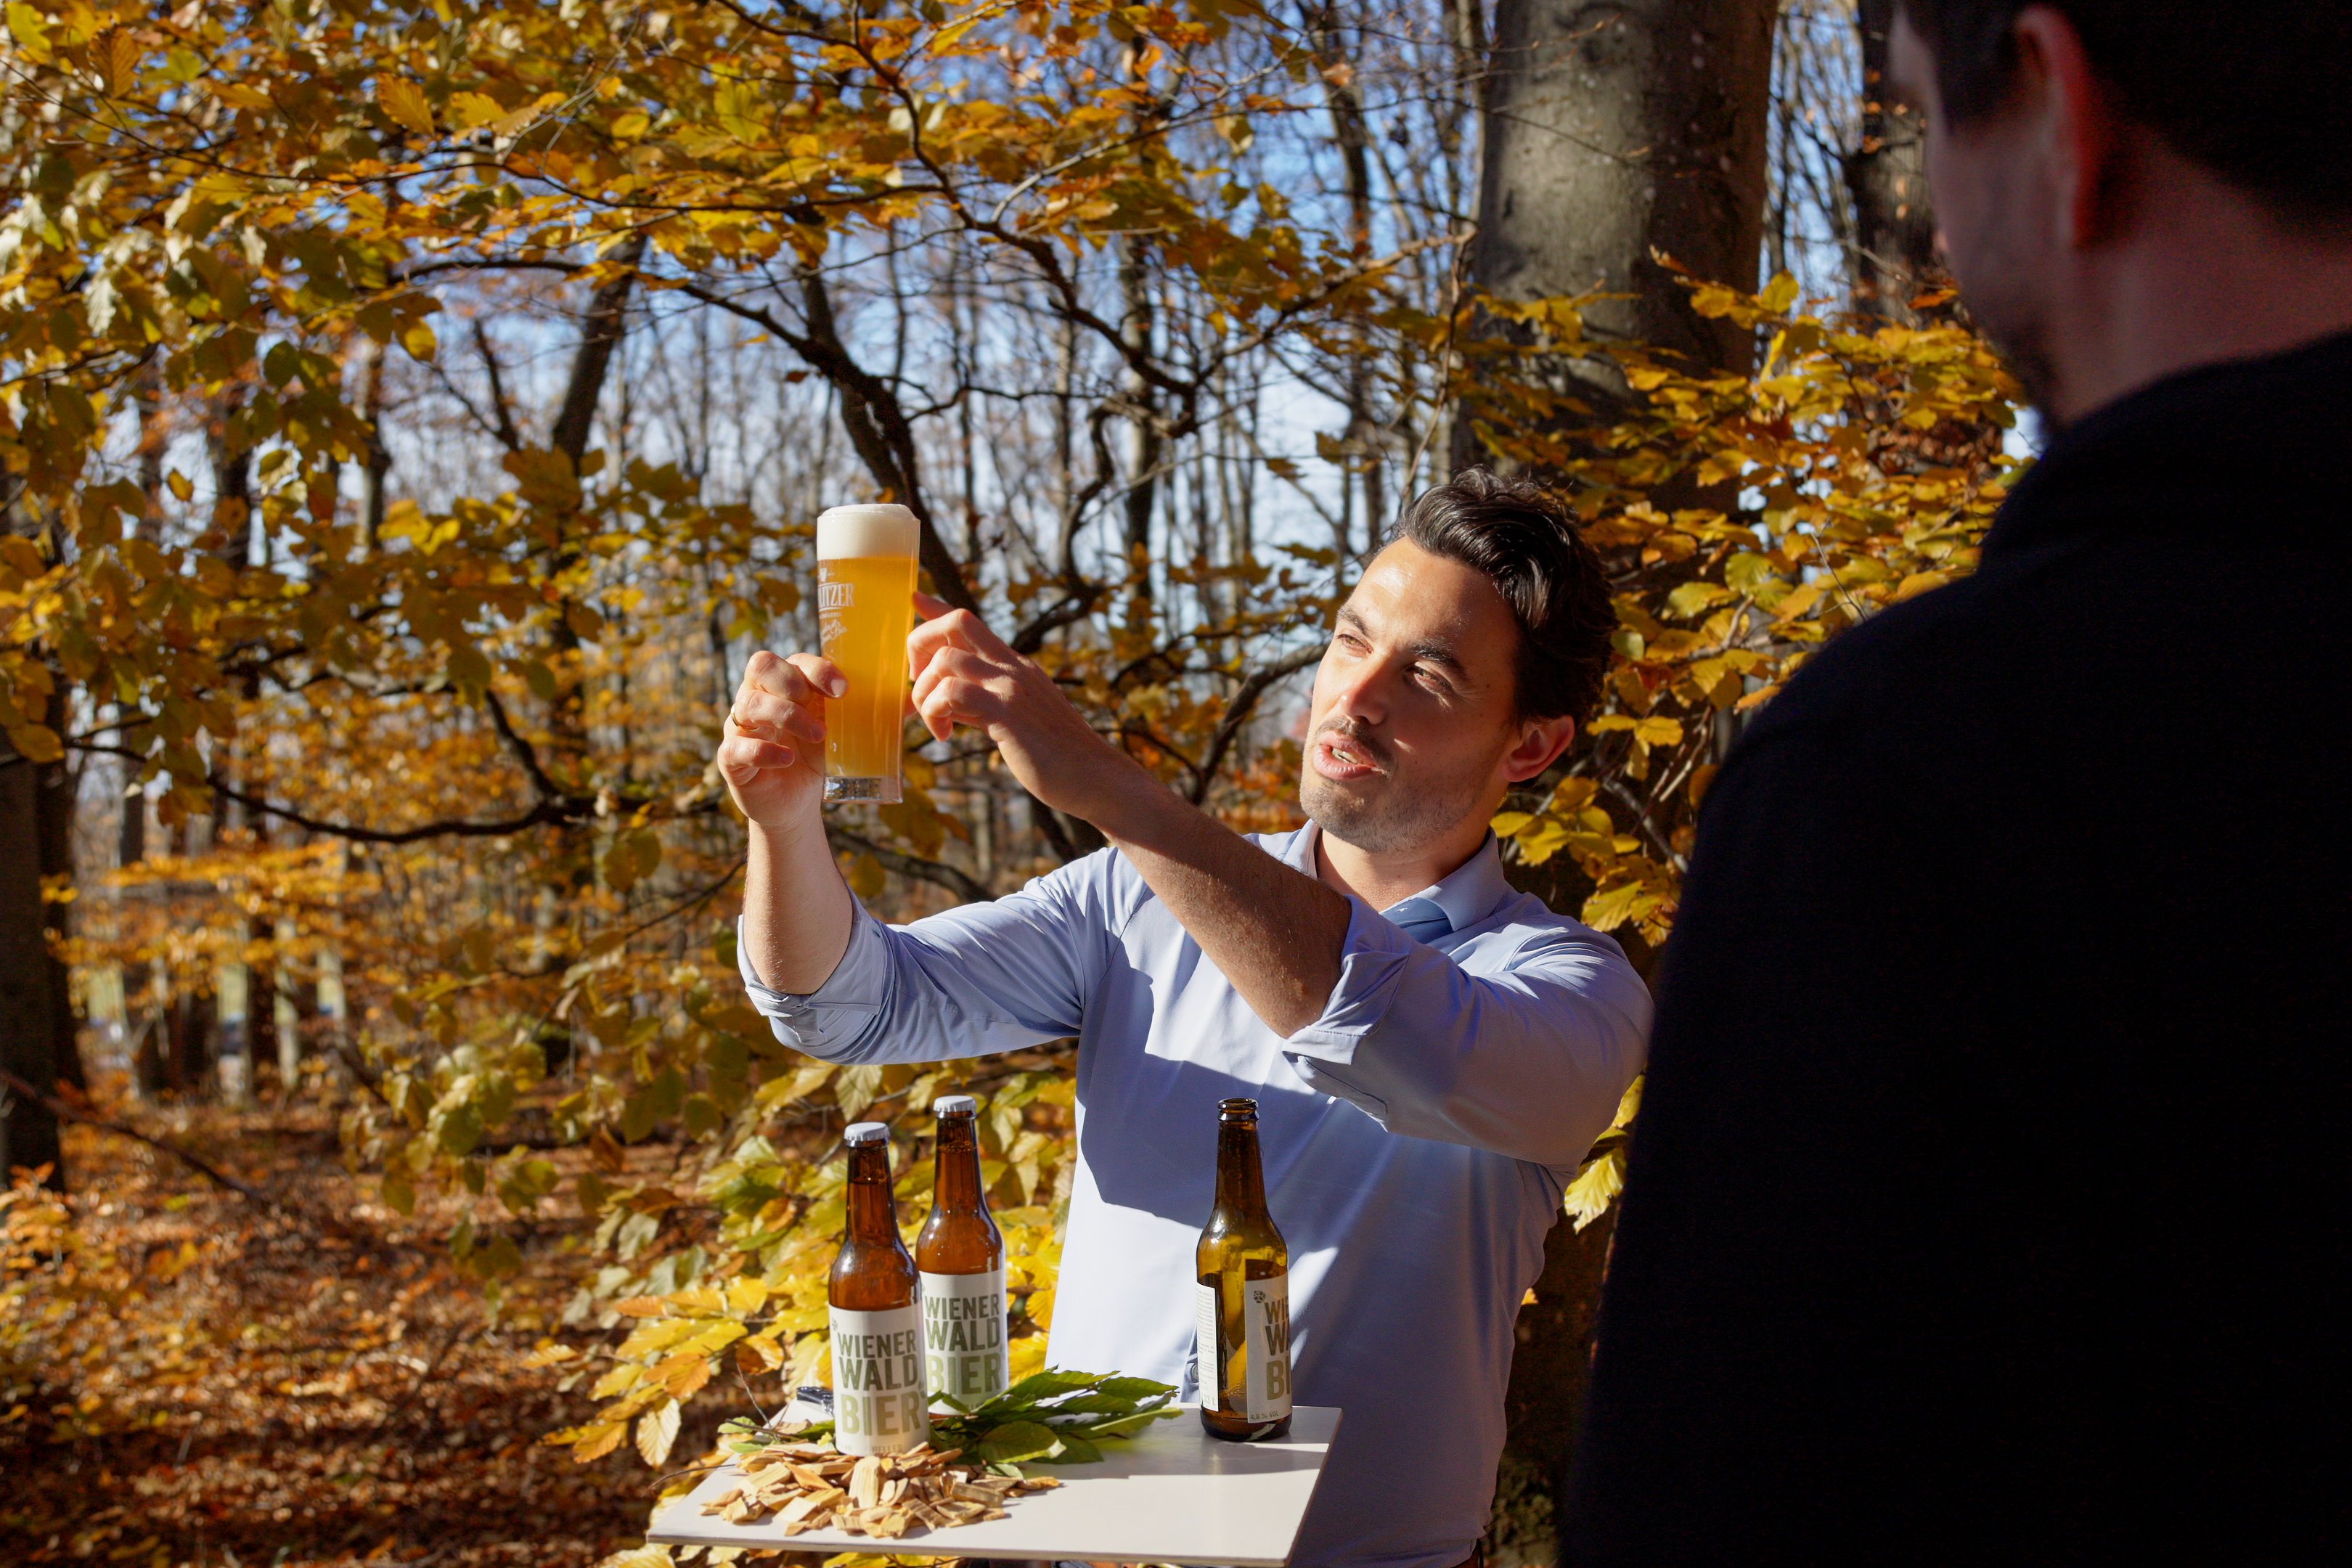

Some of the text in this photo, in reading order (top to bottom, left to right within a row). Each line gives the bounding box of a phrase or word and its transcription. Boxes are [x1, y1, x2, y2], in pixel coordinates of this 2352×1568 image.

[924, 1294, 1000, 1320] WIENER
[838, 1329, 916, 1358] WIENER
[926, 1317, 1001, 1351] WALD
[839, 1354, 918, 1391] WALD
[926, 1352, 1001, 1395] BIER
[841, 1391, 920, 1436] BIER
